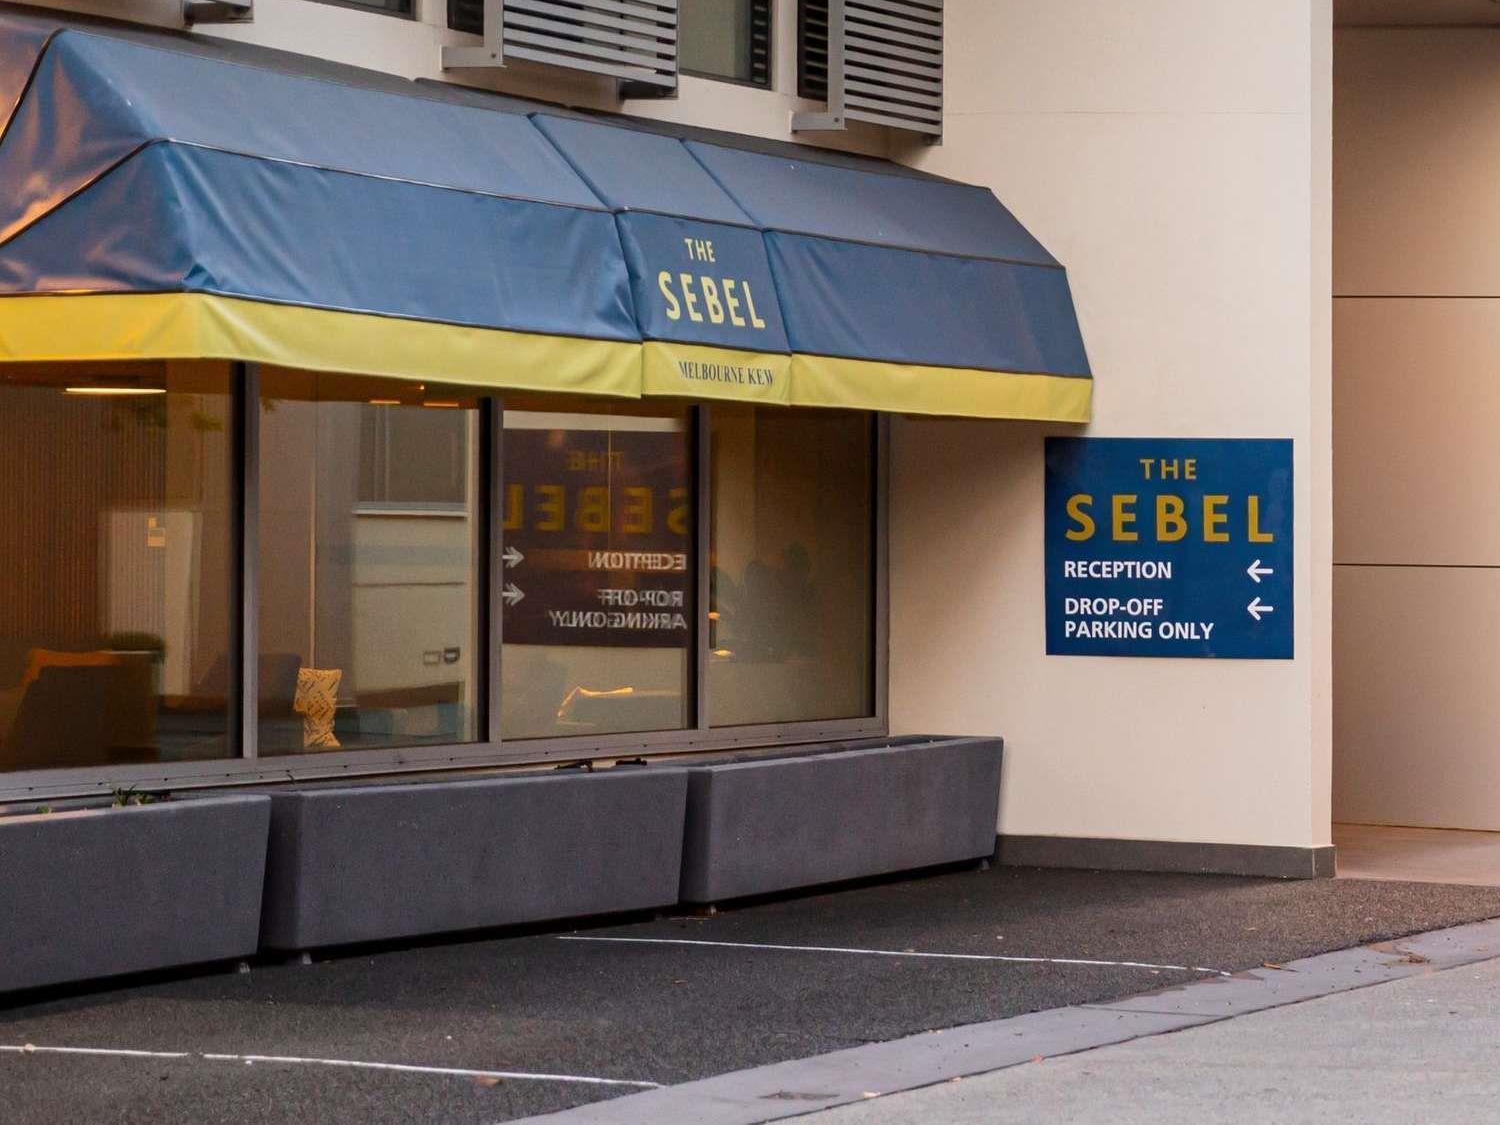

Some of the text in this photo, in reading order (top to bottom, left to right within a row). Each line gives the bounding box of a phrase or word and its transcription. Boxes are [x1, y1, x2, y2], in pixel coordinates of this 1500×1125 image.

[684, 238, 716, 262] THE
[658, 271, 766, 329] SEBEL
[678, 360, 774, 385] MELBOURNE KEW
[1139, 458, 1198, 480] THE
[1065, 493, 1274, 543] SEBEL
[1064, 561, 1172, 579] RECEPTION
[1064, 598, 1163, 616] DROP-OFF
[1064, 621, 1214, 640] PARKING ONLY
